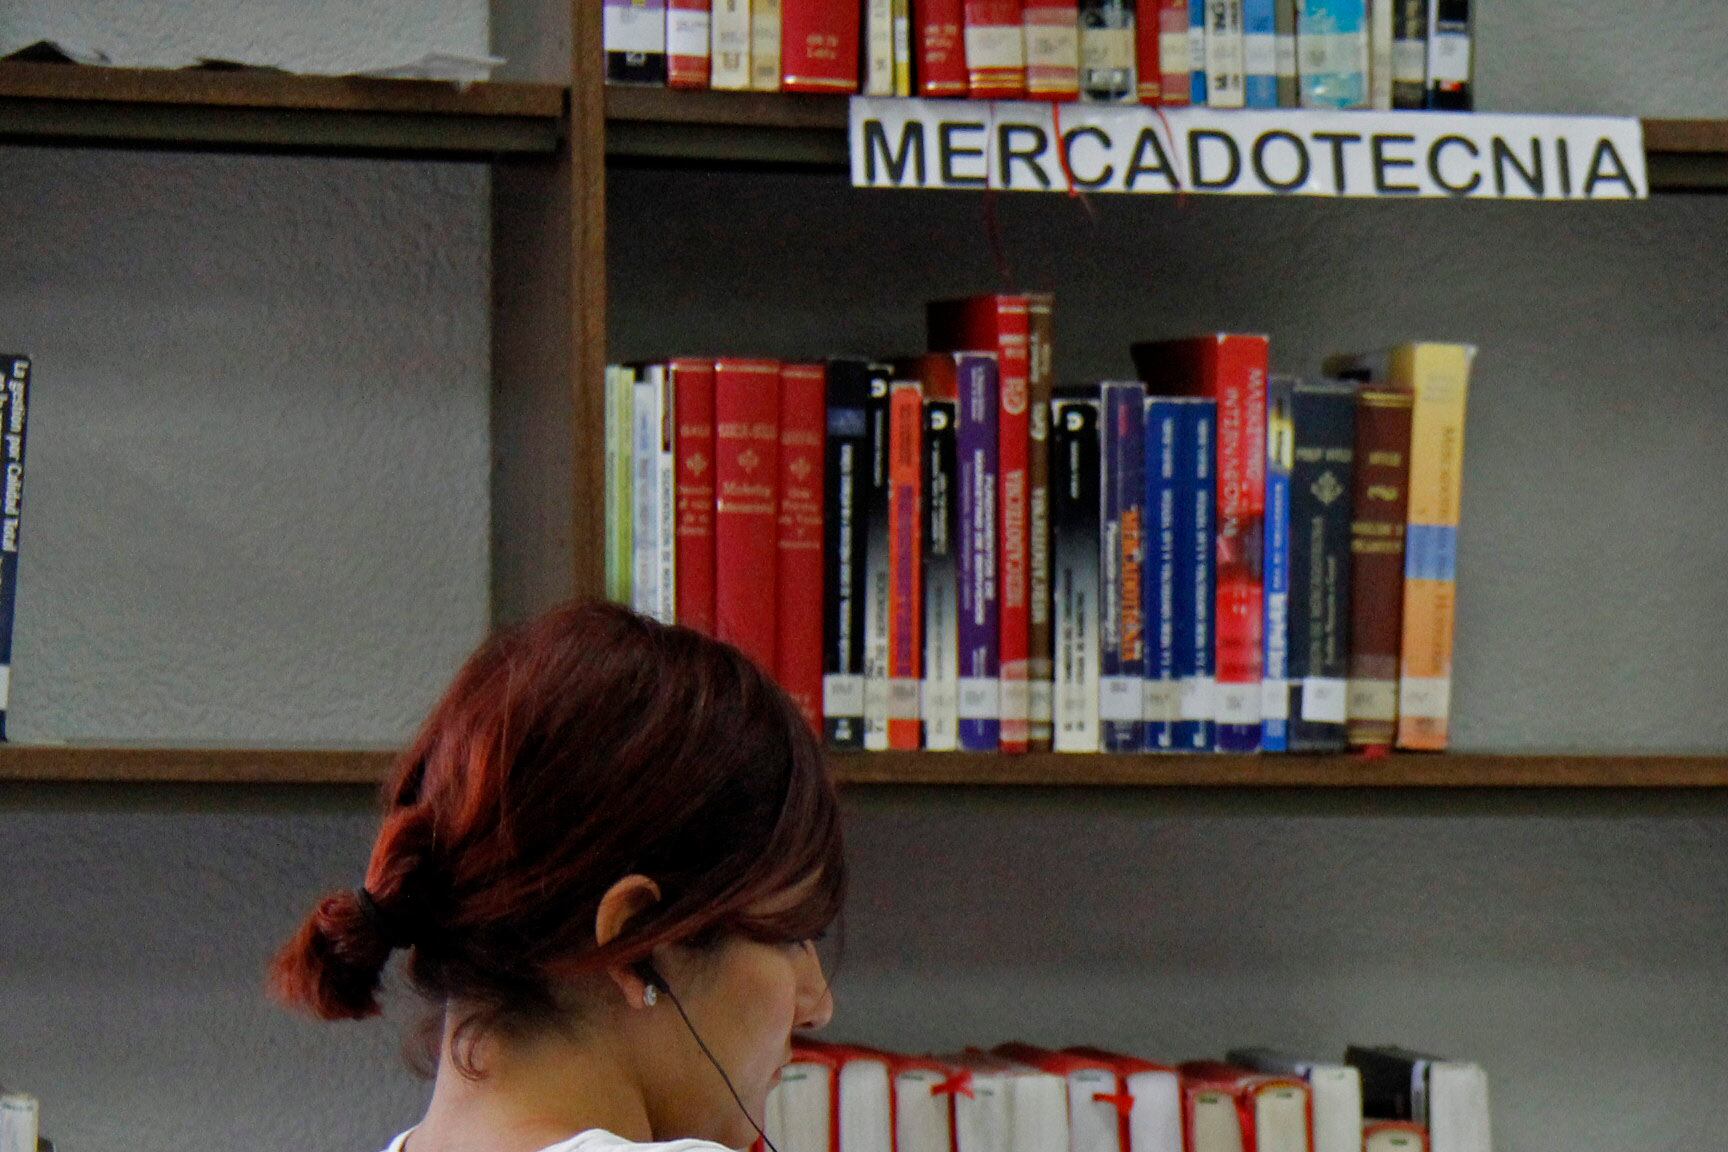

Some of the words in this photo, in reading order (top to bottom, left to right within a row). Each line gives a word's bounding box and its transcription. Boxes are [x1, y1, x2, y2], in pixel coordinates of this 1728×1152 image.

[862, 120, 1637, 198] MERCADOTECNIA
[4, 463, 22, 515] Calidad
[2, 517, 19, 553] Total
[1005, 470, 1025, 608] MERCADOTECNIA
[1030, 488, 1047, 624] MERCADOTECNIA
